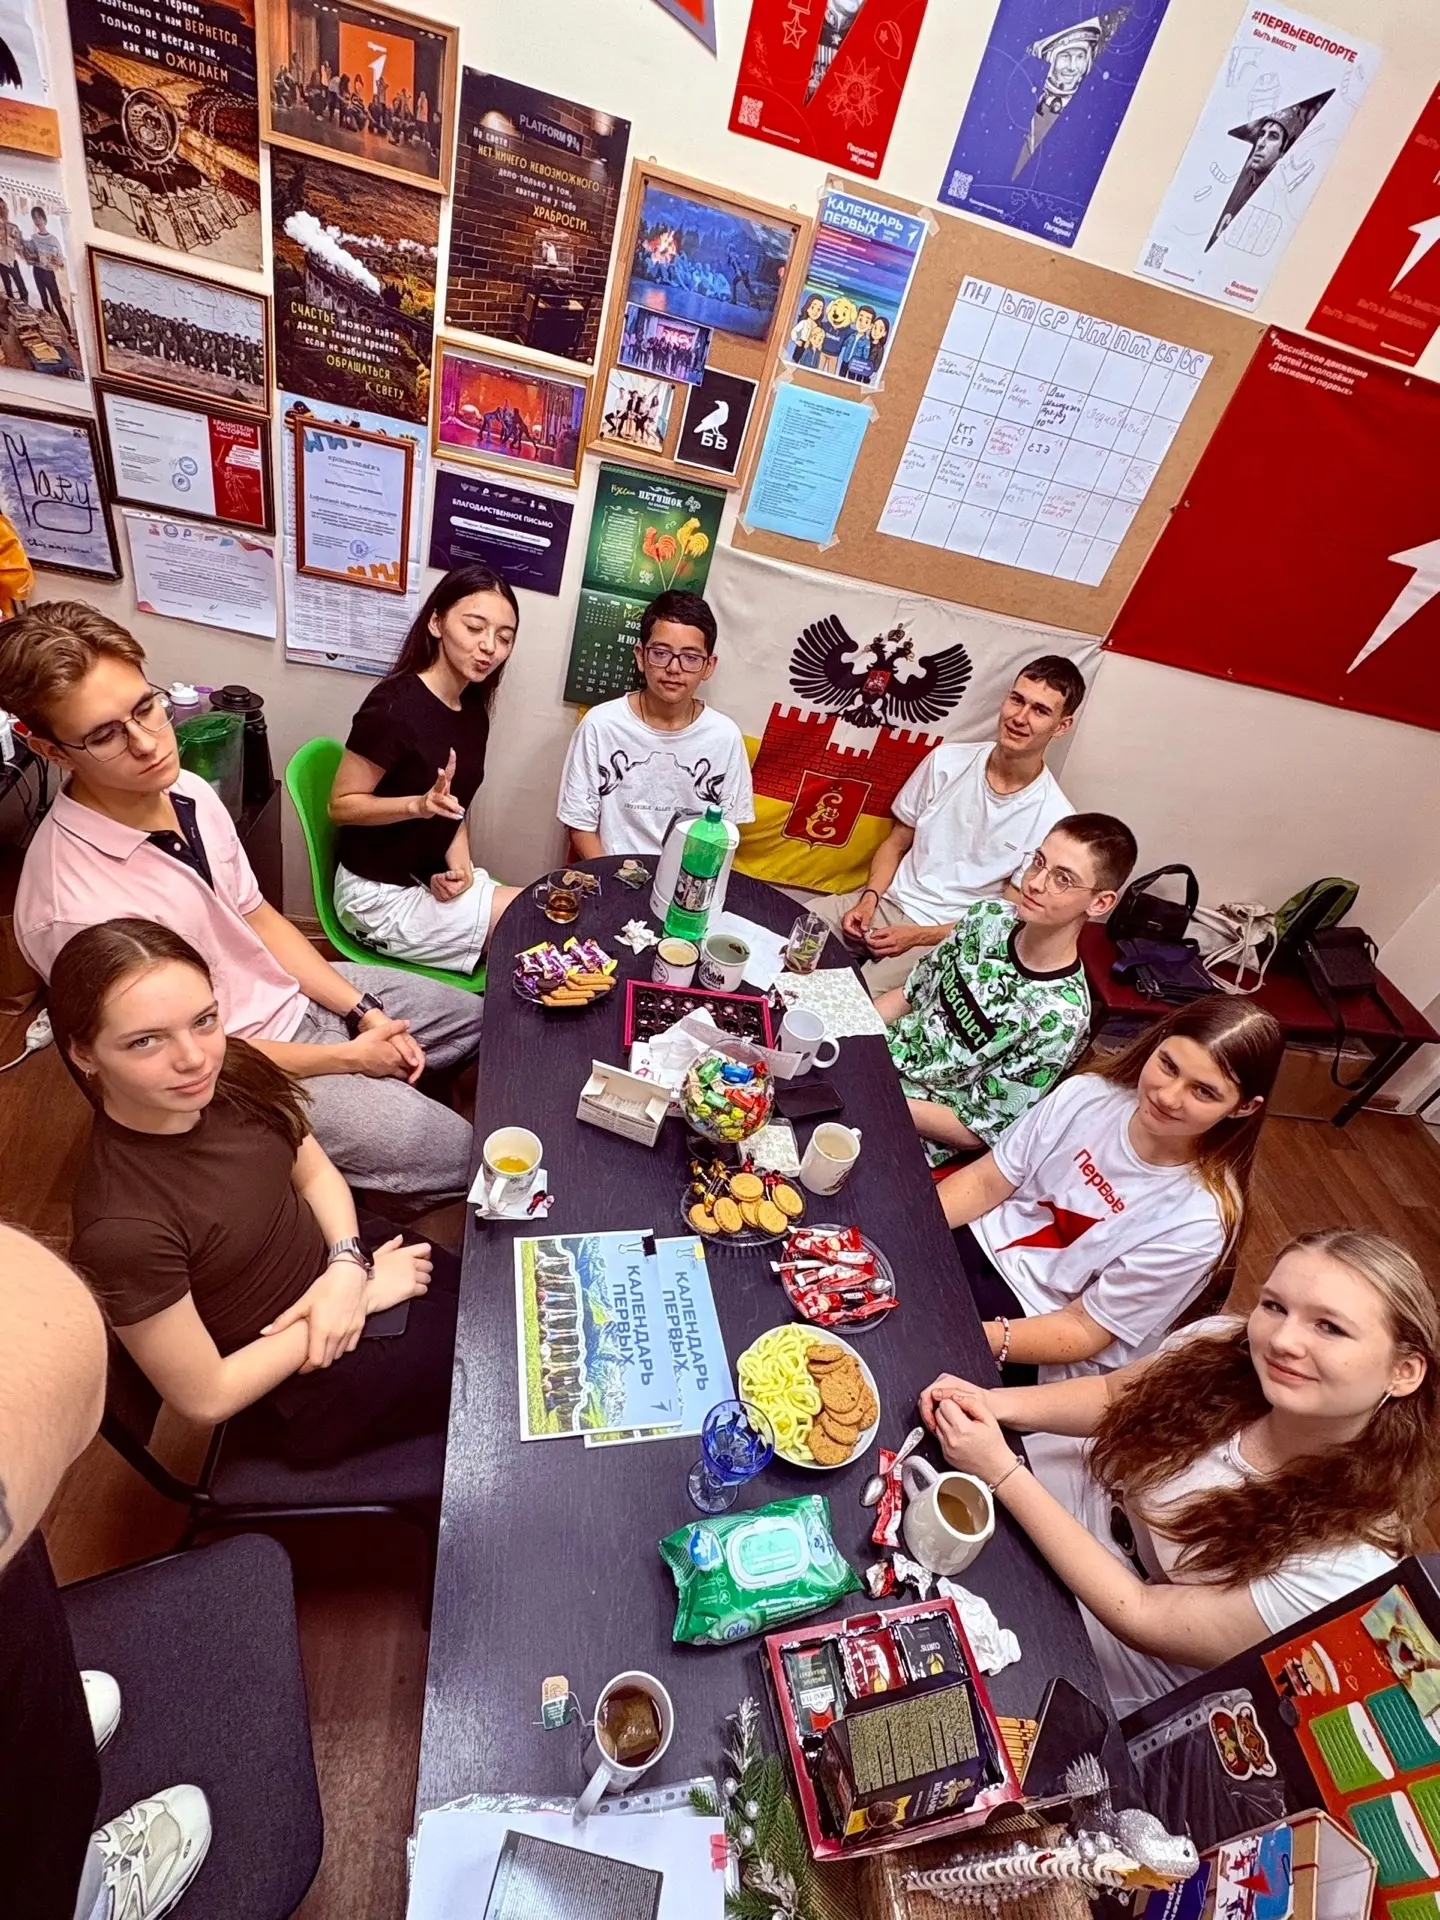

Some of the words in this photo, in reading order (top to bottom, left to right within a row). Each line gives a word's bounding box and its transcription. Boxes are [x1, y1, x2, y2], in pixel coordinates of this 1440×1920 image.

[100, 13, 141, 35] только
[145, 27, 157, 40] не
[161, 32, 195, 52] всегда
[199, 44, 221, 61] так,
[155, 12, 162, 22] к
[165, 15, 182, 28] нам
[184, 17, 238, 47] ВЕРНЕТСЯ
[1251, 9, 1359, 64] #ПЕРВЫЕВСПОРТЕ
[1253, 28, 1272, 42] БЫТЬ
[1271, 35, 1298, 53] ВМЕСТЕ
[122, 40, 141, 54] как
[144, 46, 160, 60] мы
[165, 52, 229, 83] ОЖИДАЕМ
[472, 126, 484, 138] На
[485, 133, 509, 148] свете
[519, 114, 566, 143] PLATFORM
[477, 144, 492, 160] НЕТ
[494, 149, 528, 169] НИЧЕГО
[846, 141, 878, 159] Георгий
[850, 154, 875, 169] Жуков
[515, 185, 540, 201] хватит
[823, 209, 878, 238] ПЕРВЫХ
[827, 196, 904, 232] КАЛЕНДАРЬ
[1052, 214, 1076, 229] Юрий
[1043, 221, 1072, 238] Гагарин
[1223, 286, 1255, 304] Харламов
[1230, 279, 1258, 296] Валерий
[290, 301, 336, 325] СЧАСТЬЕ
[341, 318, 372, 334] можно
[375, 327, 401, 342] найти
[296, 320, 319, 334] даже
[364, 337, 402, 356] времена,
[304, 336, 326, 349] если
[328, 342, 340, 353] не
[341, 345, 382, 364] забывать
[326, 354, 392, 381] ОБРАЩАТЬСЯ
[1271, 338, 1326, 364] Российское
[1323, 359, 1369, 379] движение
[1274, 353, 1303, 368] детей
[1301, 362, 1309, 370] и
[1308, 365, 1355, 385] молодёжи
[375, 384, 406, 401] СВЕТУ
[1267, 361, 1317, 384] «Движение
[1315, 378, 1354, 396] первых»
[700, 432, 728, 451] БВ
[452, 497, 523, 522] БЛАГОДАРСТВЕННОЕ
[523, 514, 554, 530] ПИСЬМО
[638, 490, 684, 508] ПЕТУШОК
[941, 966, 989, 1047] Discover
[1072, 1148, 1126, 1215] Первые
[612, 1283, 636, 1367] ПЕРВЫХ
[626, 1264, 655, 1387] КАЛЕНДАРЬ
[662, 1289, 691, 1373] ПЕРВЫХ
[675, 1271, 710, 1392] КАЛЕНДАРЬ
[920, 1643, 941, 1653] CURTIS
[926, 1779, 944, 1816] RICHARD
